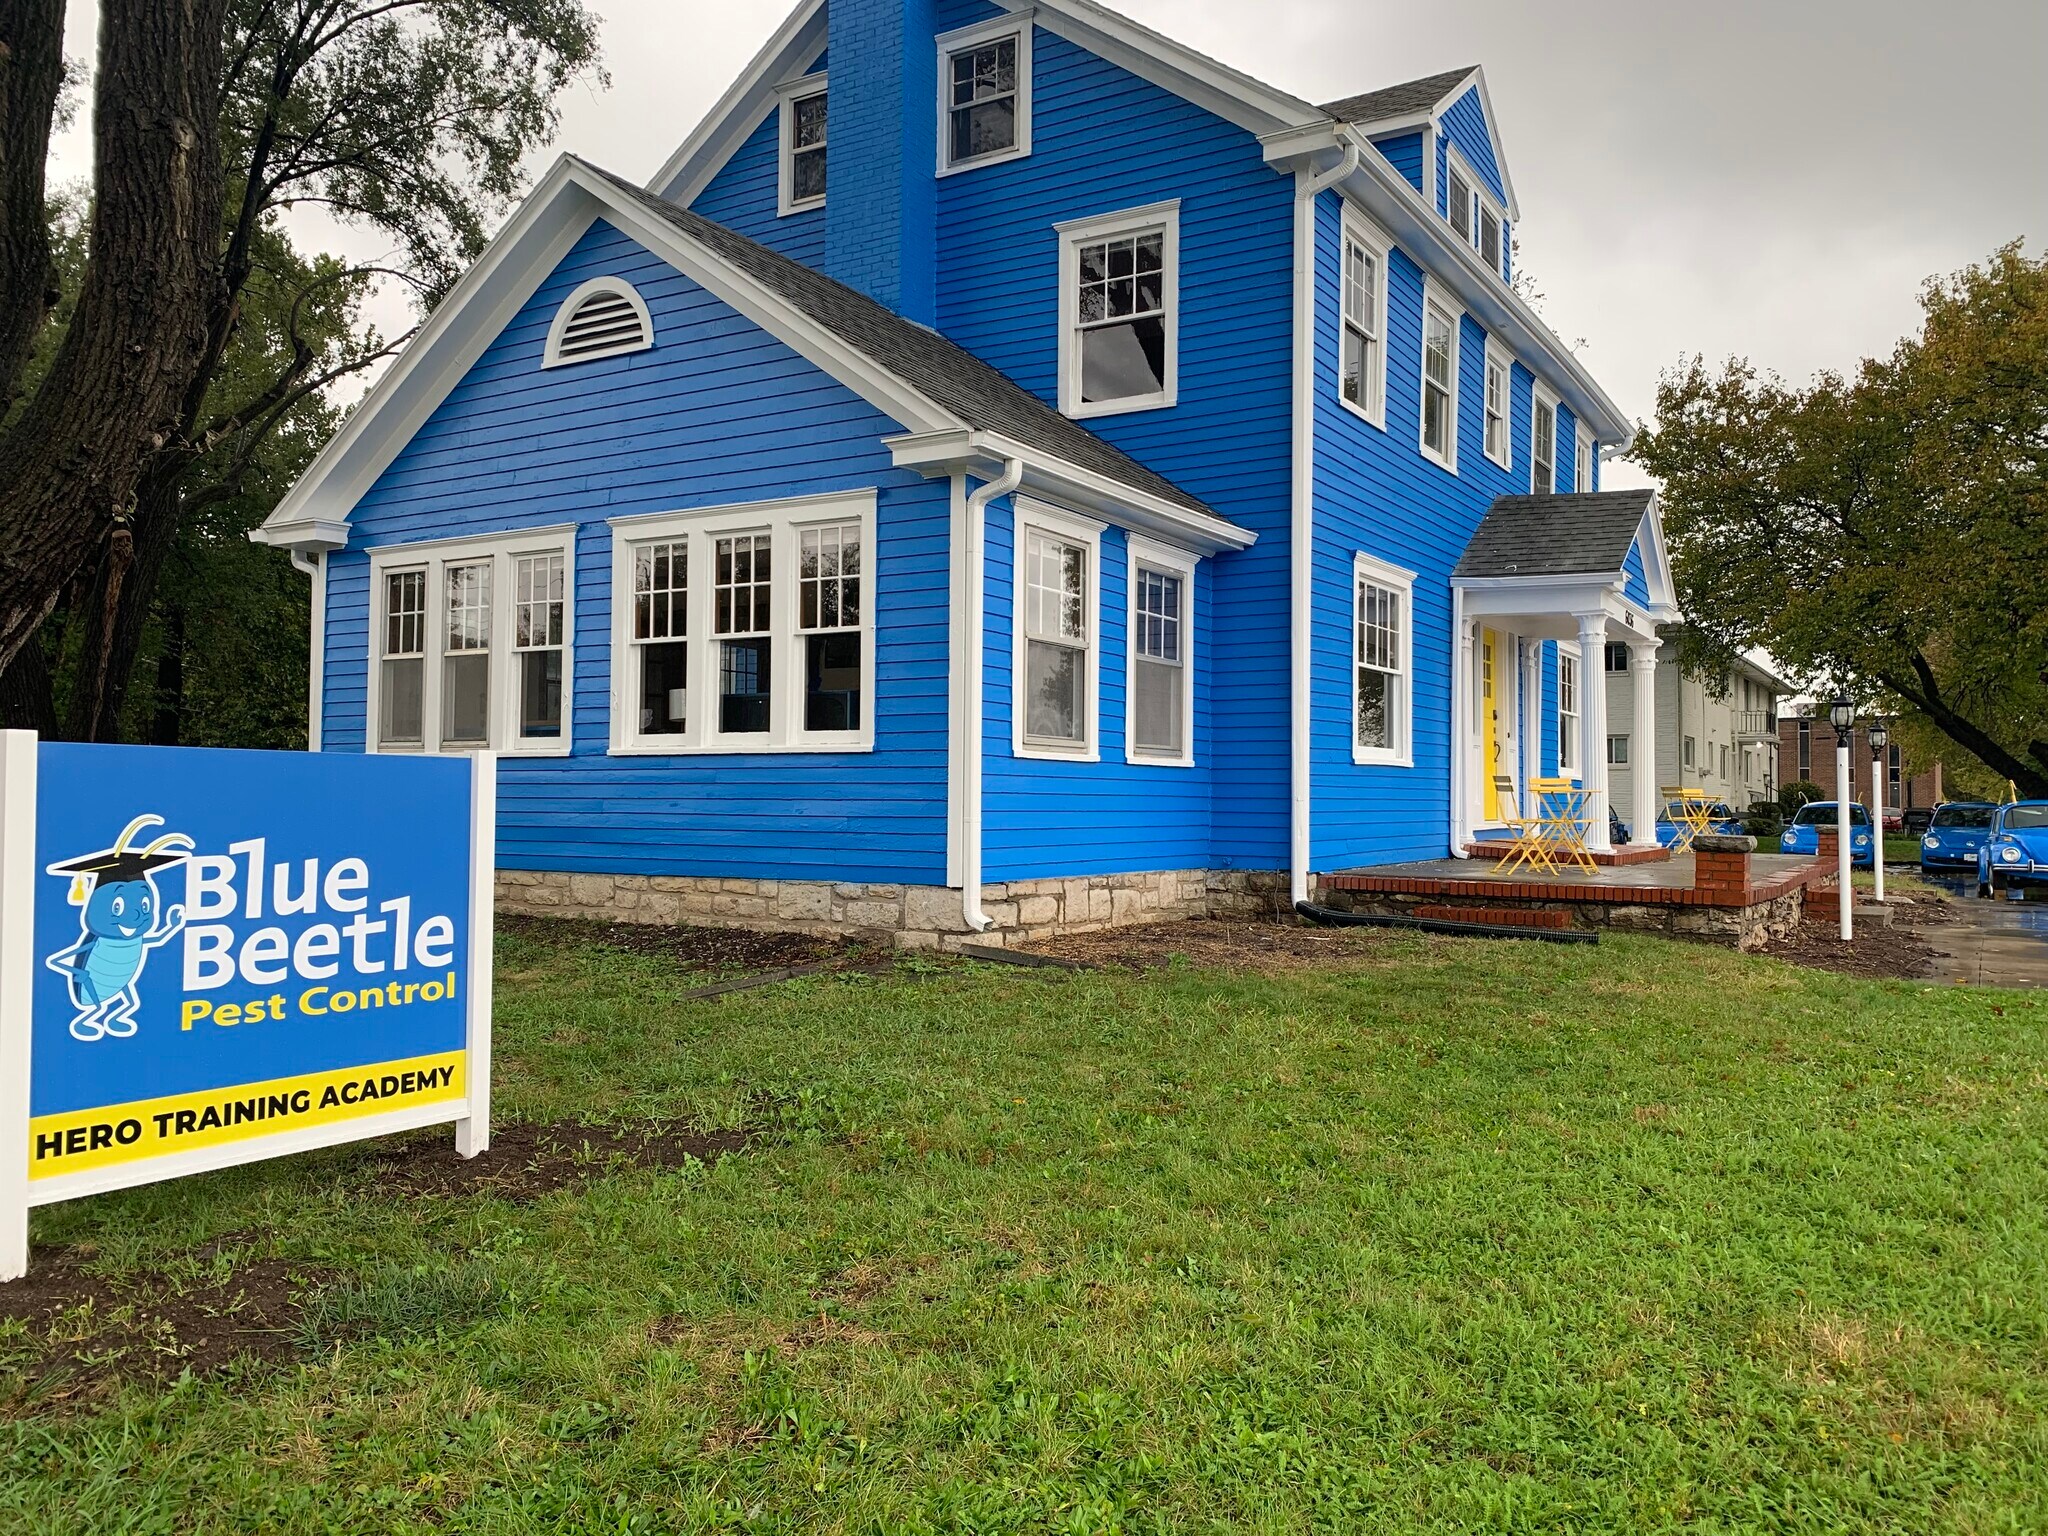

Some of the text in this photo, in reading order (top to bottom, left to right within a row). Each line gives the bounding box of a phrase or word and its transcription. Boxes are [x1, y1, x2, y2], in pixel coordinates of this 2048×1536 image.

[186, 837, 370, 921] Blue
[182, 895, 456, 992] Beetle
[181, 972, 456, 1031] Pest Control
[35, 1065, 456, 1160] HERO TRAINING ACADEMY
